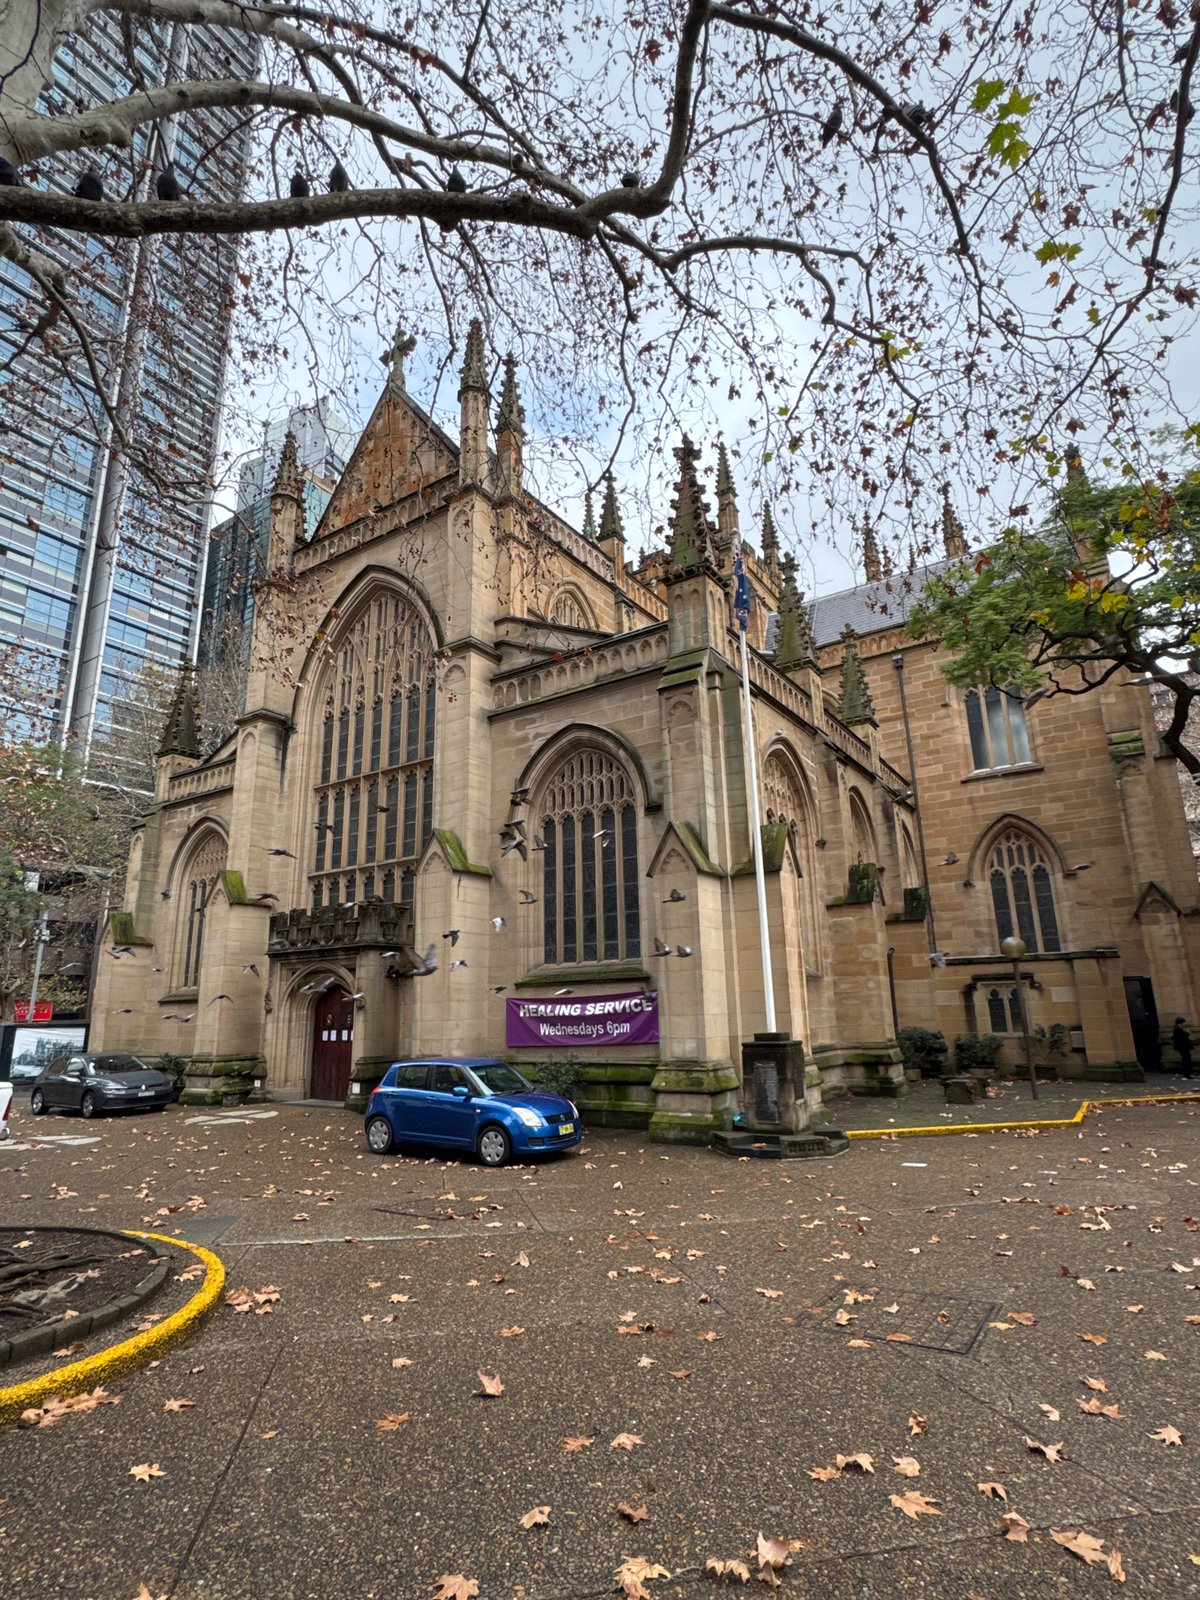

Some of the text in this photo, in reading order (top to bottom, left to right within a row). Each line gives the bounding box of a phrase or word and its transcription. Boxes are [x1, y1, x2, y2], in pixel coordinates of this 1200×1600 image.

[519, 999, 652, 1018] HEALING SERVICE
[540, 1021, 630, 1038] Wednesdays 6pm
